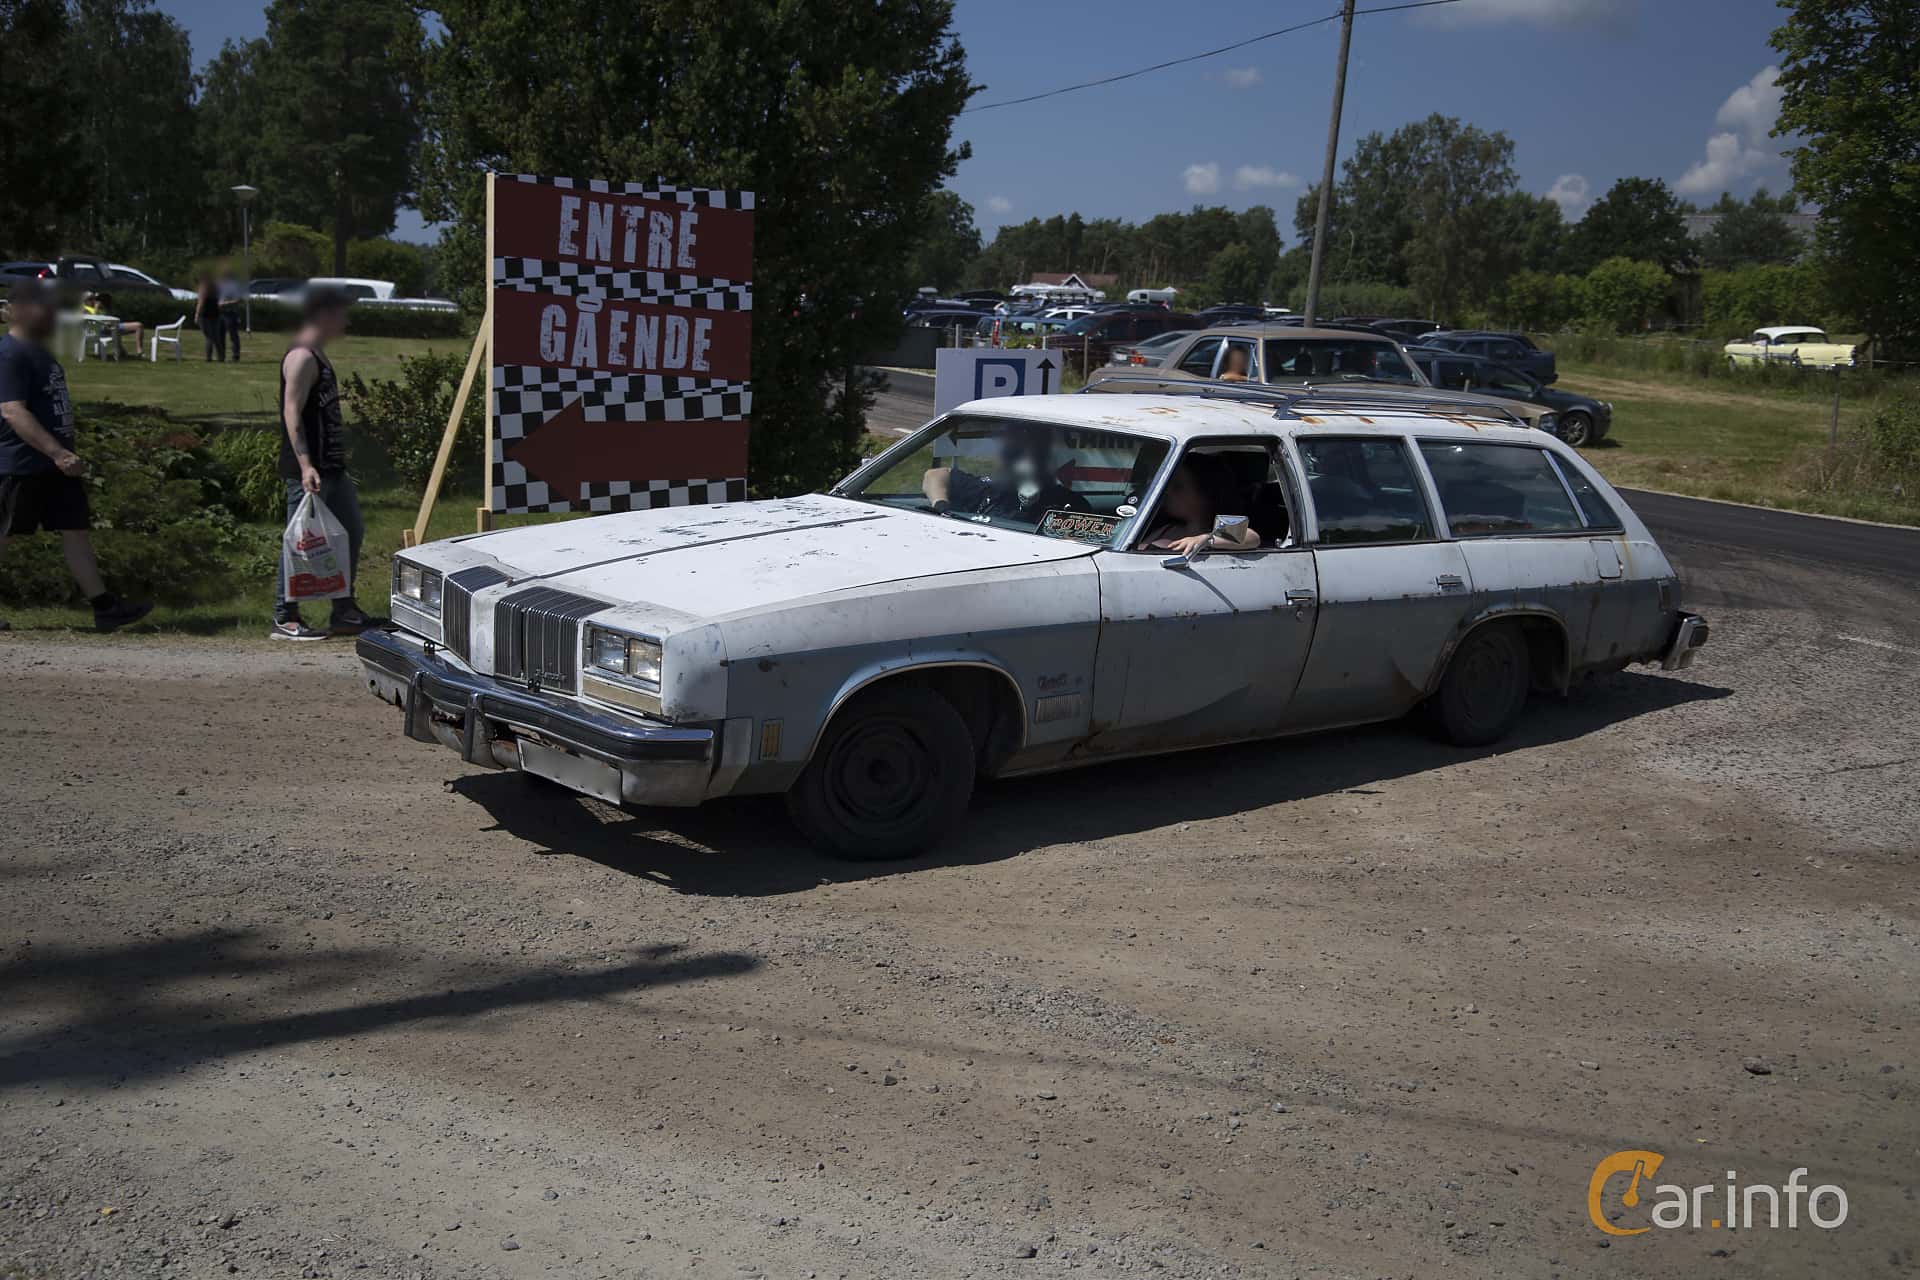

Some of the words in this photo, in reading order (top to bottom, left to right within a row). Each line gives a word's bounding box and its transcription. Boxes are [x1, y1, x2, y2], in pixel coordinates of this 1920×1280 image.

[558, 196, 699, 269] ENTRÉ
[539, 293, 713, 372] GÅENDE
[981, 363, 1019, 399] P
[1048, 516, 1116, 537] POWER
